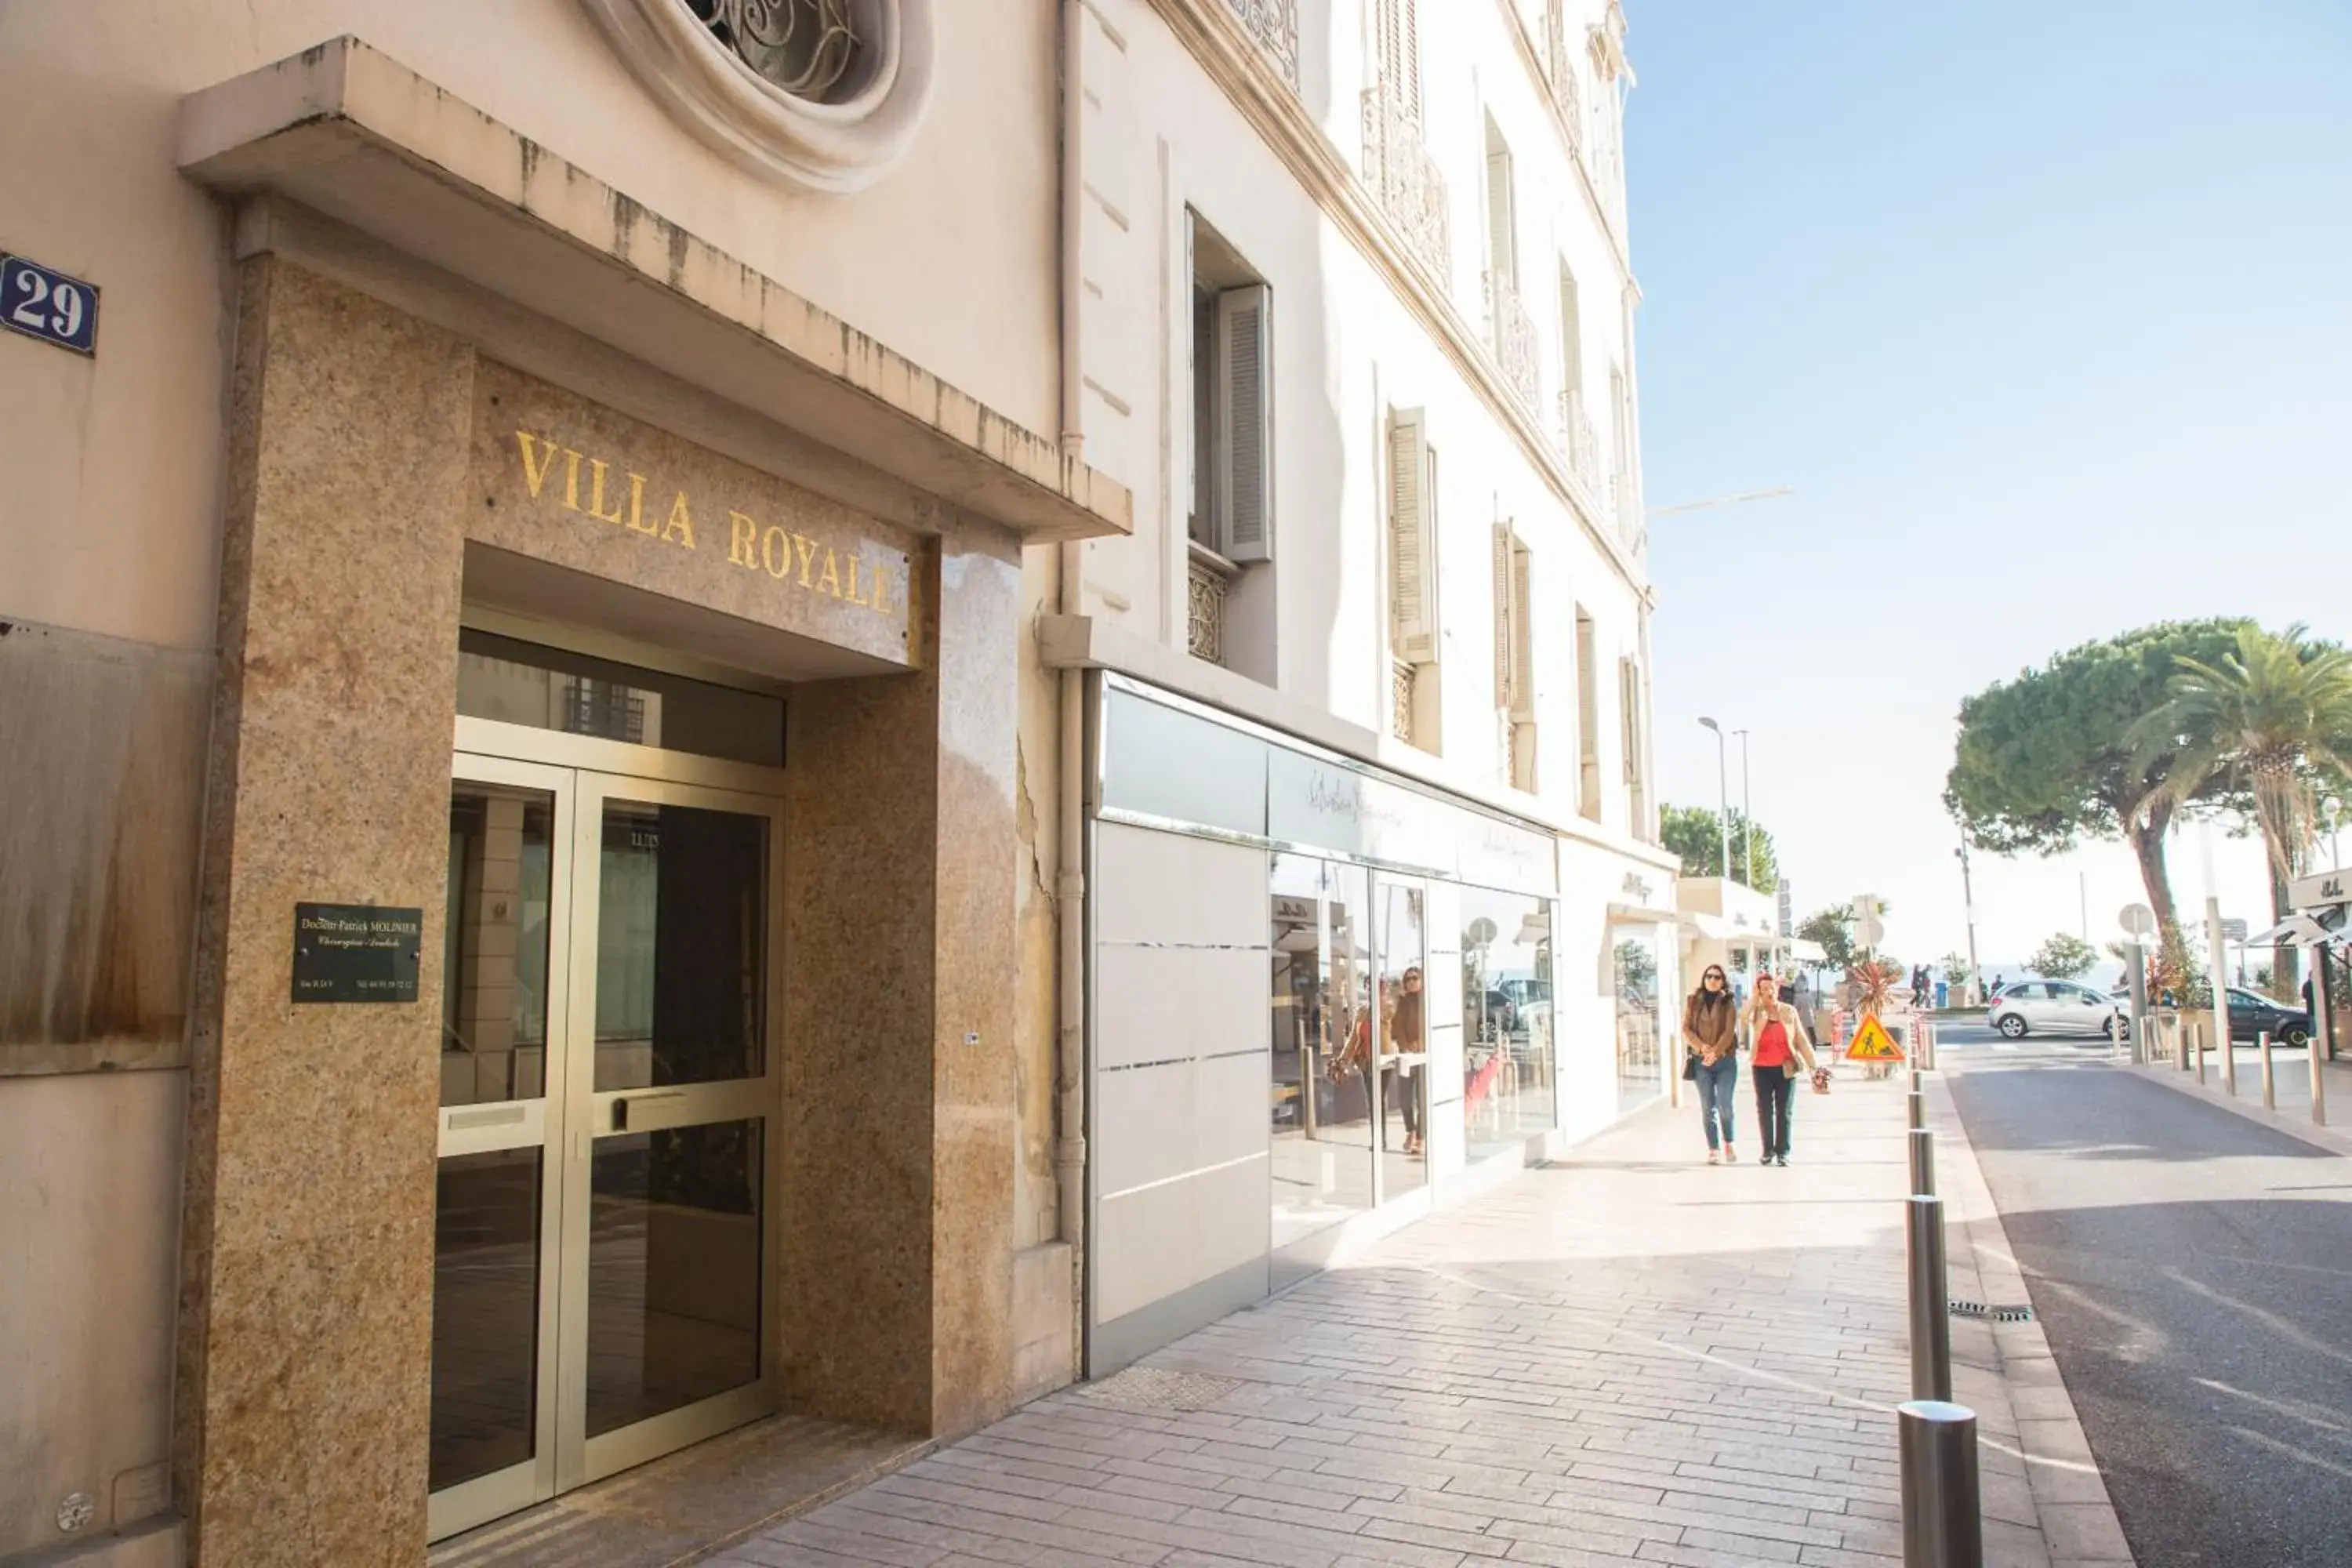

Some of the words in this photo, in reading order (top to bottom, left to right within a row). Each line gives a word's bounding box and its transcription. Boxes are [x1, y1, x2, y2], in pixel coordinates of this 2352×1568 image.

[13, 269, 83, 337] 29
[516, 430, 696, 550] VILLA
[727, 510, 892, 614] ROYALE
